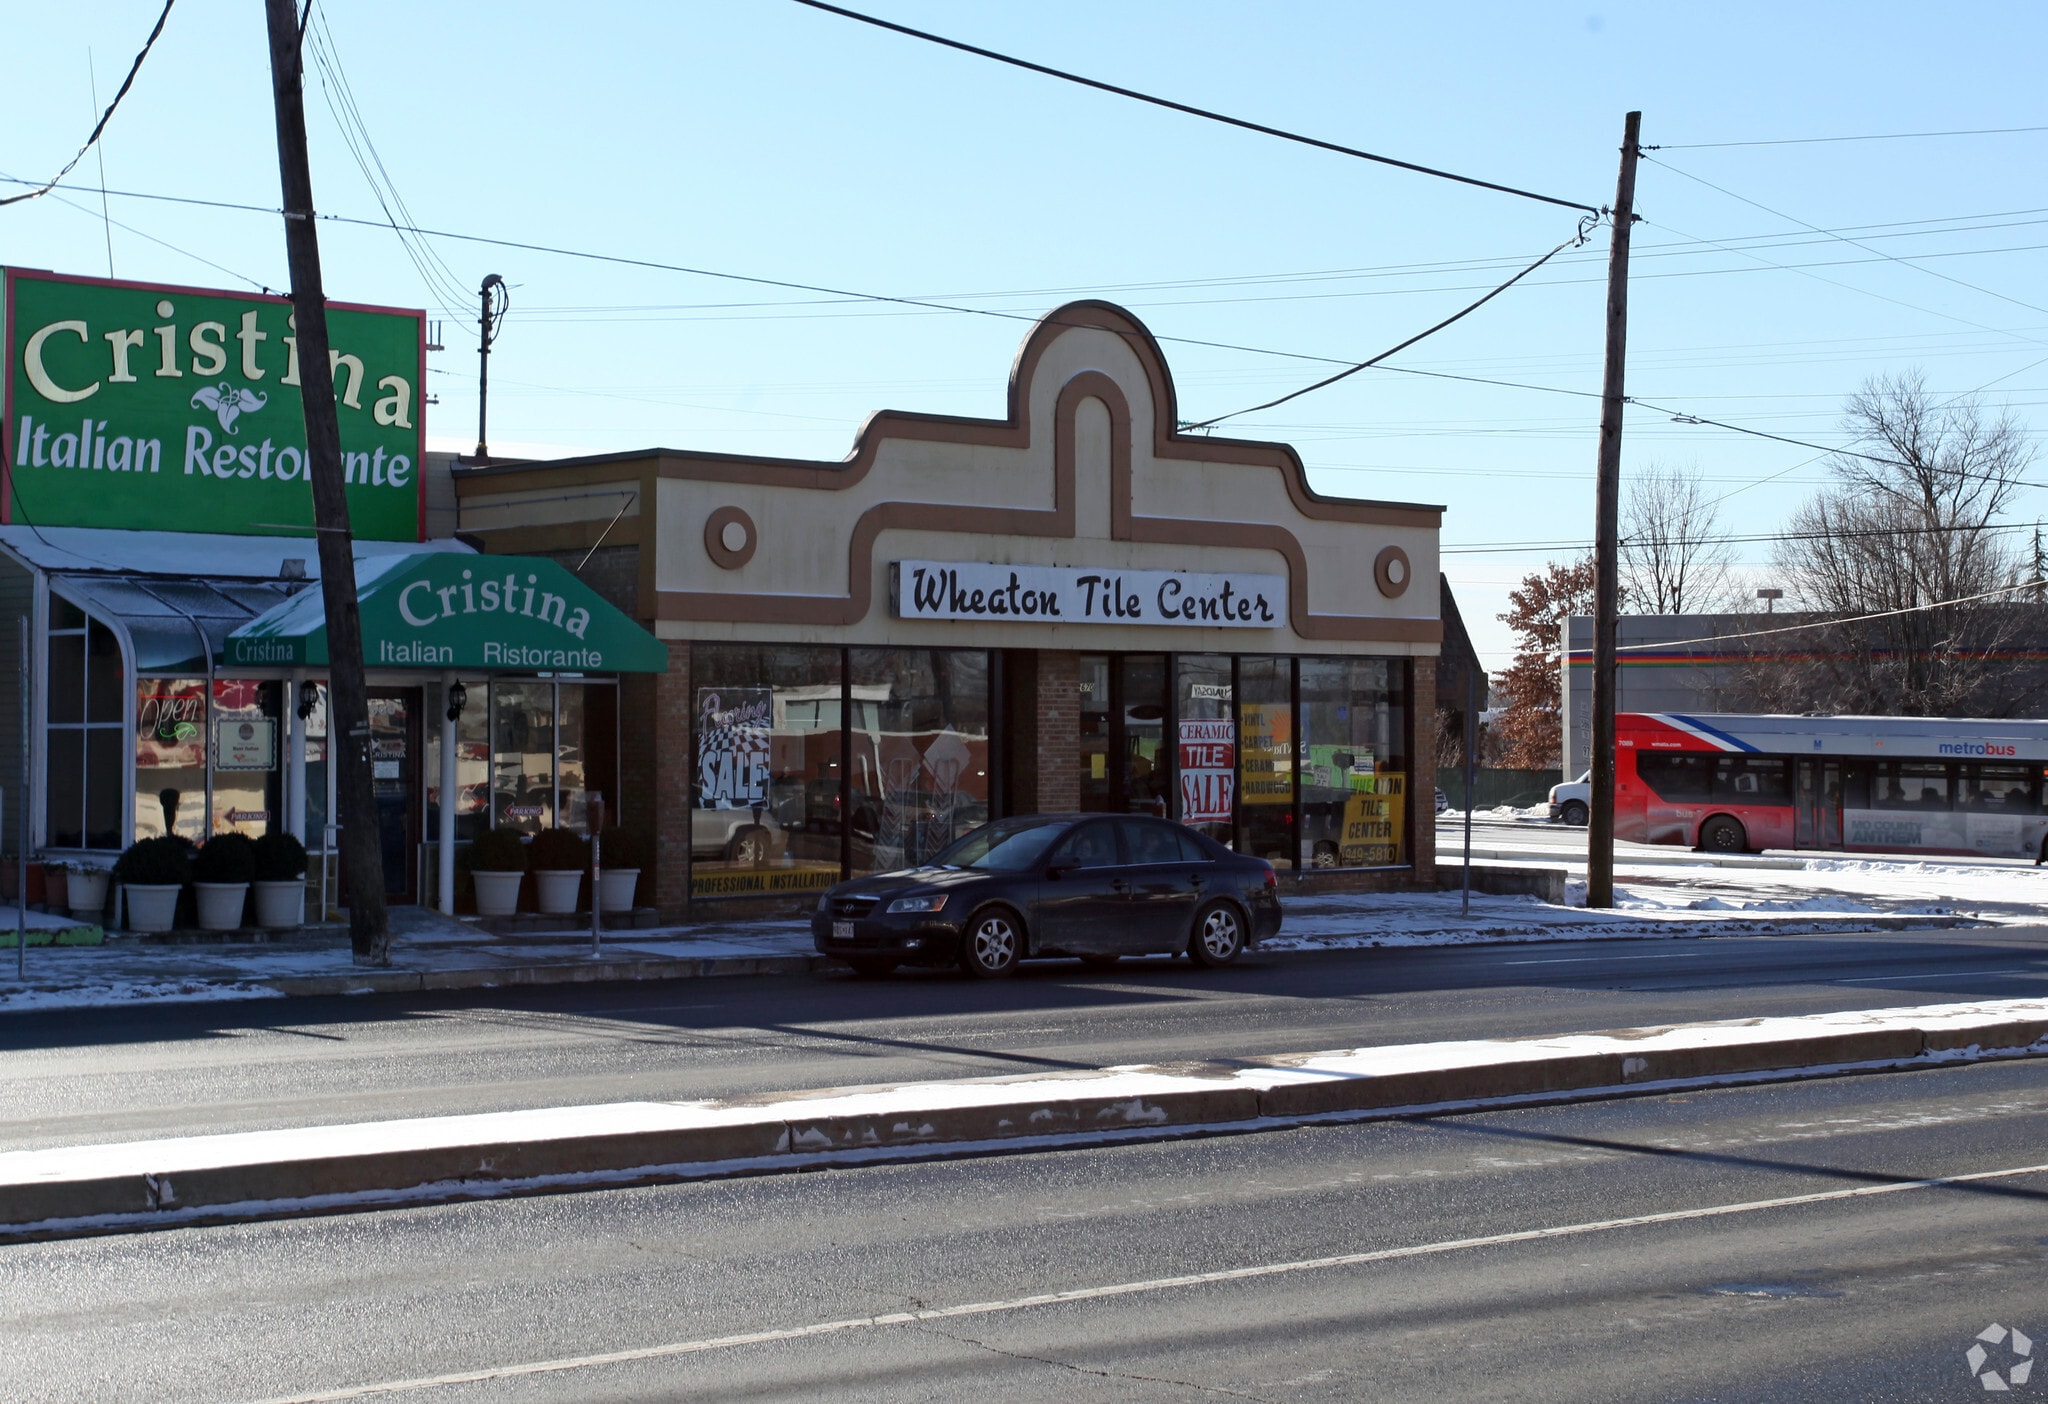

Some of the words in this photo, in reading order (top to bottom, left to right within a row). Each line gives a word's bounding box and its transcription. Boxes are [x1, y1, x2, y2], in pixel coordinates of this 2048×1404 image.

[24, 300, 412, 429] Cristina
[17, 416, 160, 473] Italian
[184, 425, 411, 488] Restonte
[912, 567, 1061, 616] Wheaton
[1077, 575, 1142, 617] Tile
[1157, 578, 1274, 623] Center
[398, 569, 591, 640] Cristina
[235, 638, 294, 662] Cristina
[380, 640, 453, 663] Italian
[483, 644, 602, 668] Ristorante
[141, 698, 198, 740] Open
[1244, 713, 1266, 727] VINYL
[1179, 724, 1234, 740] CERAMIC
[1244, 735, 1274, 749] CARPET
[1939, 742, 2016, 756] metrobus
[373, 751, 406, 759] RISTINA
[1186, 746, 1225, 768] TILE
[702, 751, 764, 800] SALE
[1181, 774, 1232, 817] SALE
[1246, 781, 1291, 794] HARDWOOD
[231, 812, 267, 820] PARKING
[510, 808, 542, 816] PARKING
[1361, 800, 1382, 817] TILE
[1349, 822, 1392, 839] CENTER
[1873, 821, 1923, 831] COUNTY
[1852, 831, 1922, 845] ANTHEM
[692, 873, 765, 894] PROFESSIONAL
[769, 871, 838, 891] INSTALLATION
